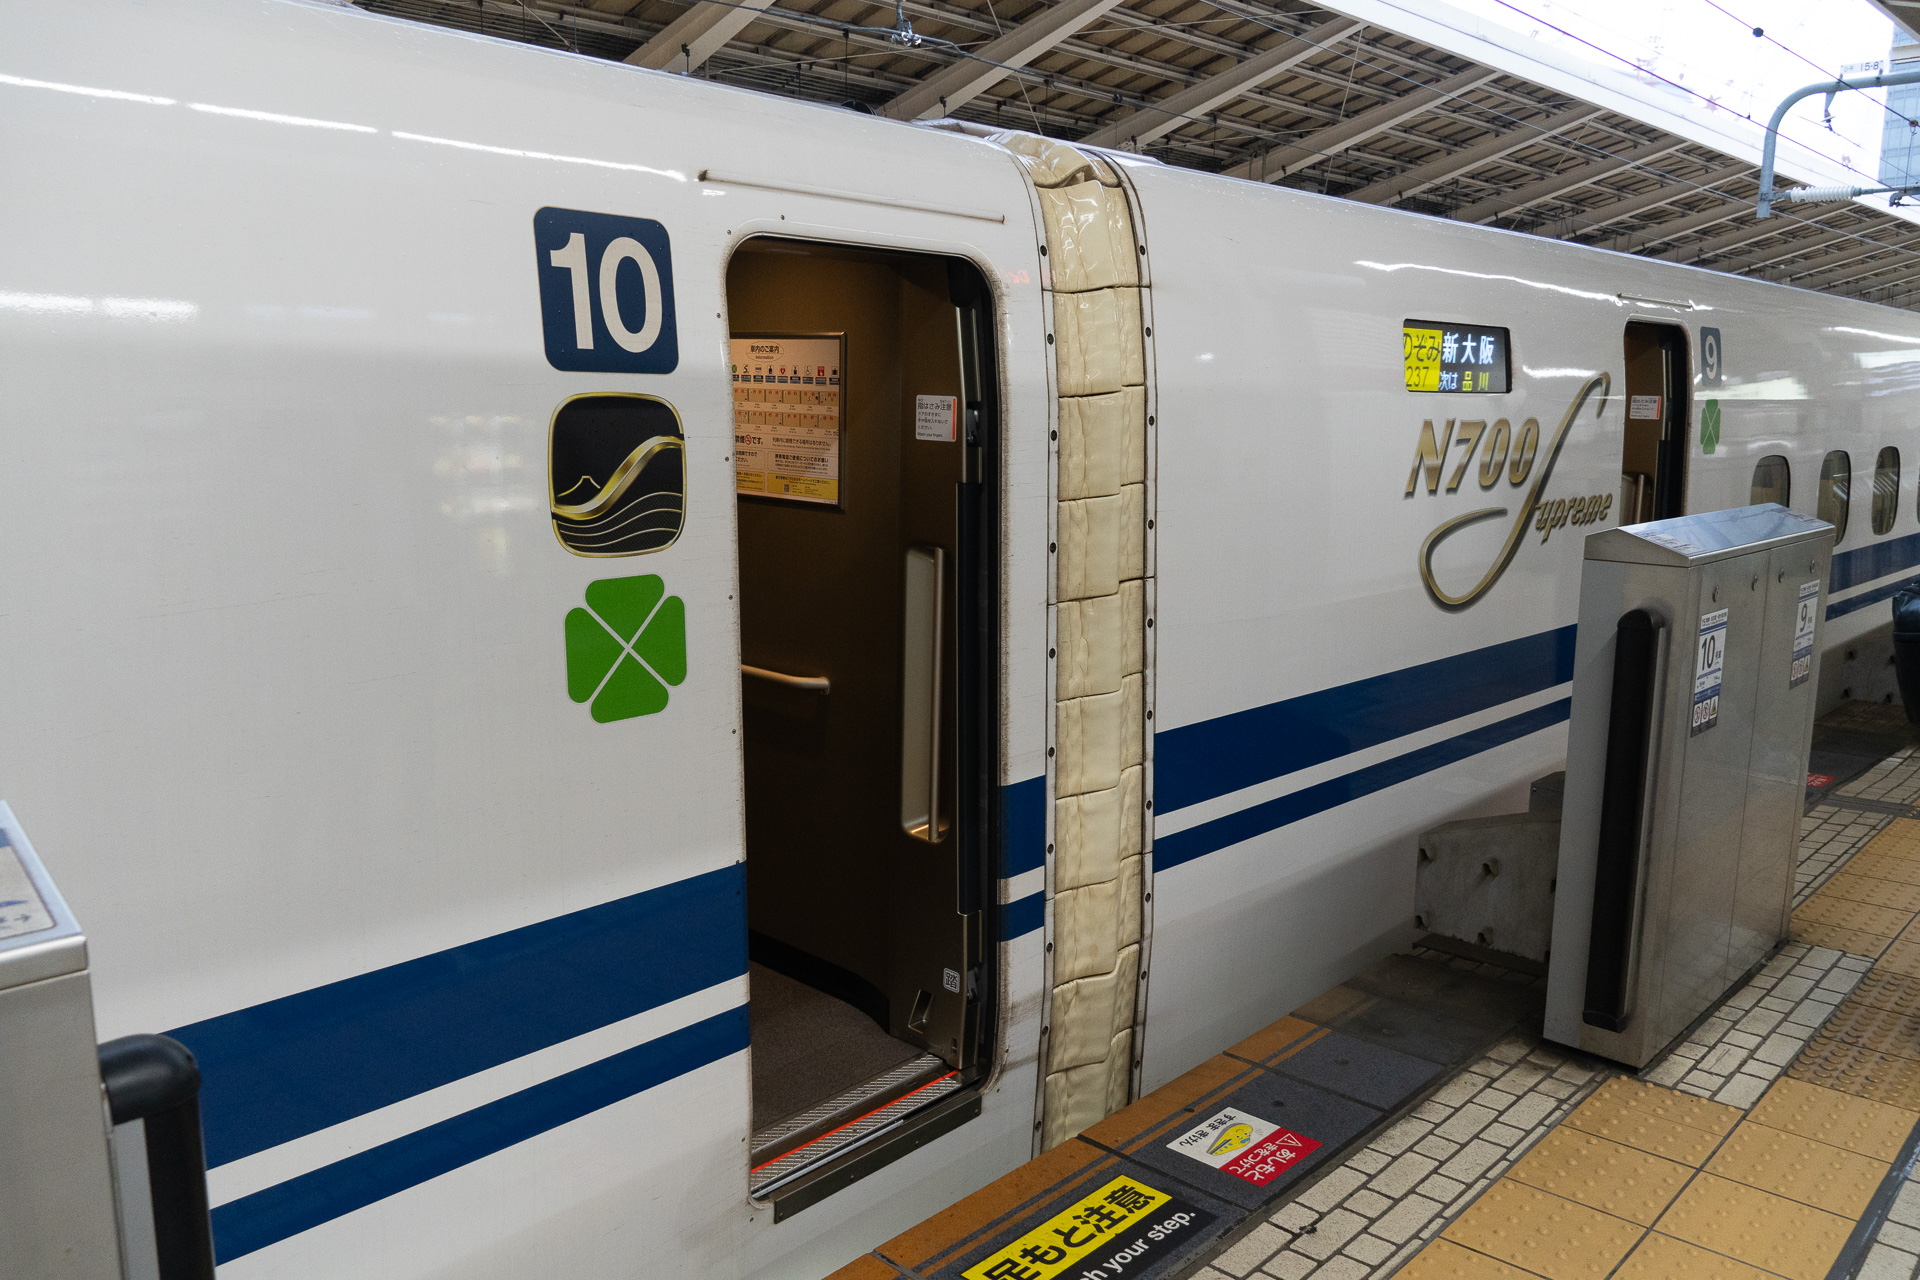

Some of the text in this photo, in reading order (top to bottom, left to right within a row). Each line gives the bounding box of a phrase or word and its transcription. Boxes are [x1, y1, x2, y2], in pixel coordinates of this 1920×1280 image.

[550, 232, 663, 353] 10
[1403, 333, 1440, 363] のぞみ
[1442, 332, 1495, 365] 新大阪
[1705, 335, 1718, 380] 9
[1406, 366, 1429, 388] 237
[1438, 370, 1489, 391] 次は 品川
[1404, 417, 1539, 498] N700
[1799, 602, 1808, 633] 9
[1701, 634, 1716, 671] 10
[1179, 1113, 1237, 1147] すきま きけん
[1228, 1142, 1278, 1174] きをつけて
[1243, 1148, 1296, 1181] あしもと
[982, 1184, 1156, 1280] 足もと注意
[1102, 1210, 1196, 1273] your step.
